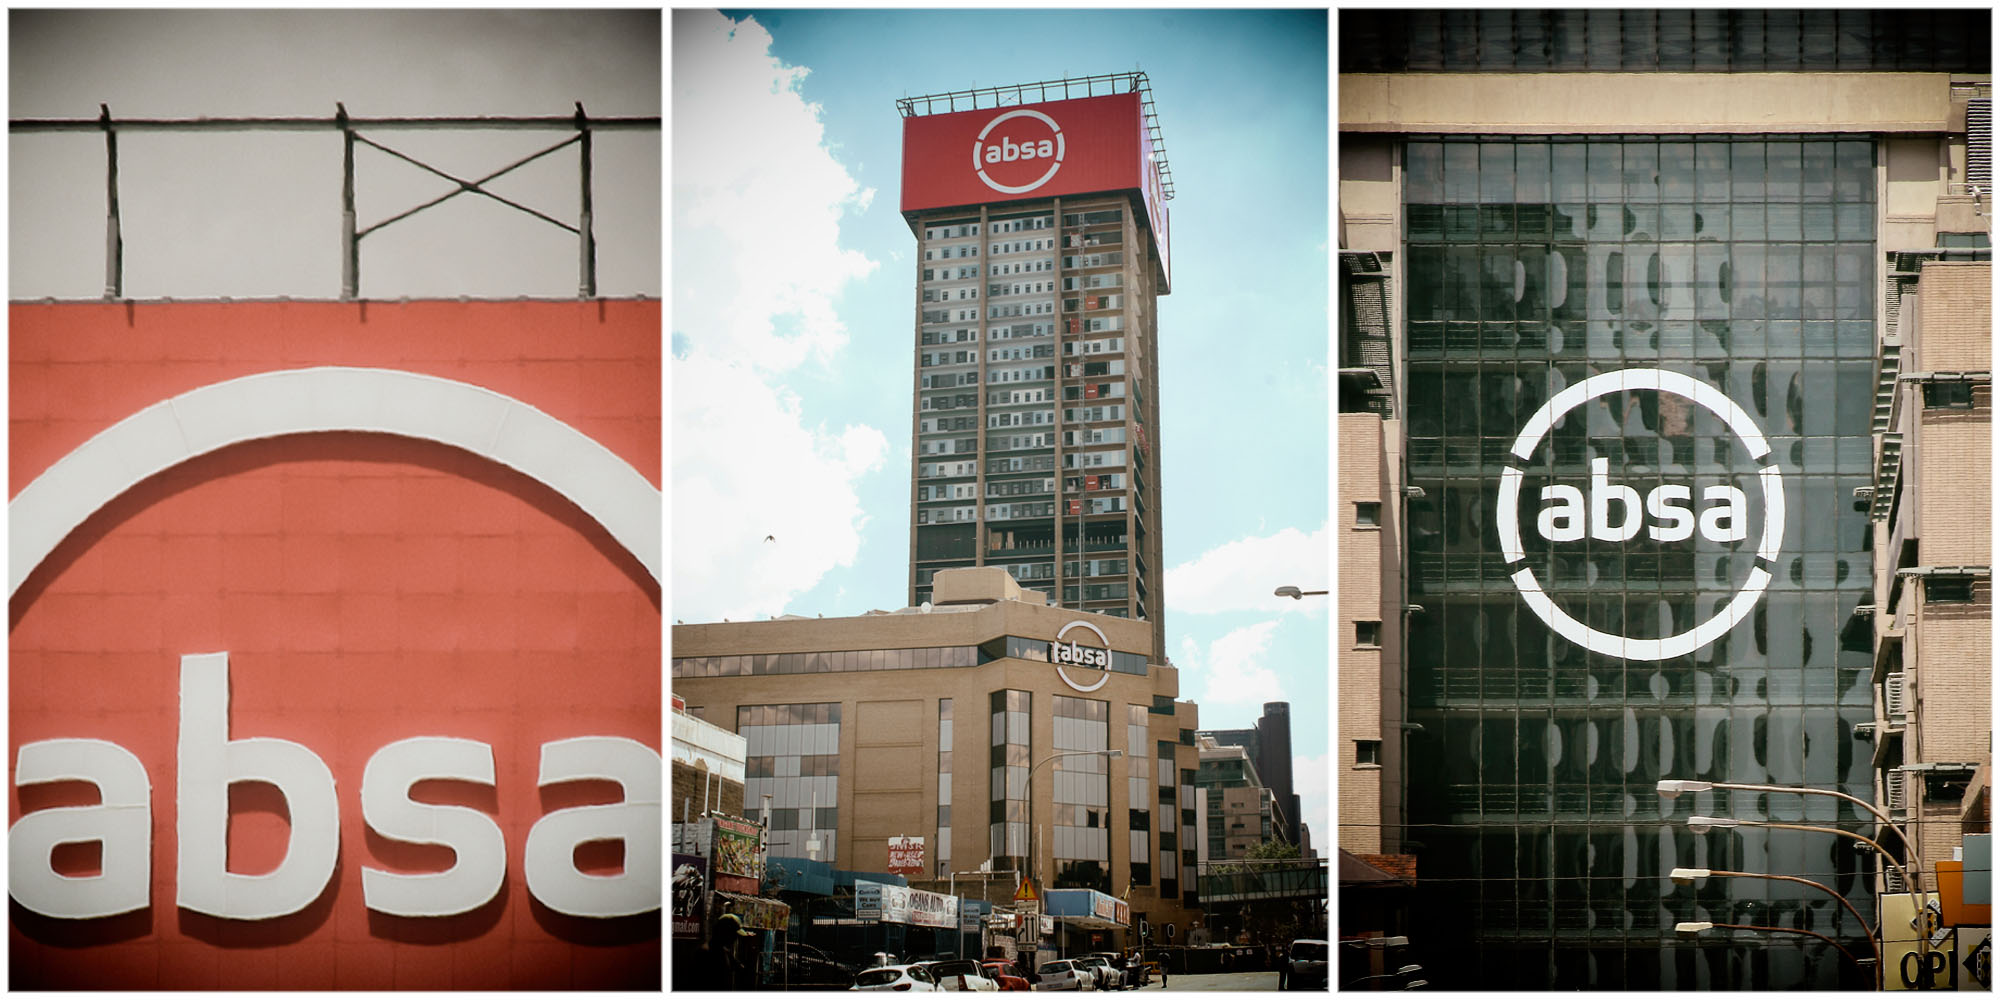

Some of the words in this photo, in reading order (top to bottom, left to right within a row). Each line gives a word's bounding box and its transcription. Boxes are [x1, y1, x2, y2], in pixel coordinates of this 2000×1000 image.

[985, 136, 1054, 164] absa
[1537, 457, 1747, 542] absa
[1060, 639, 1106, 666] absa
[8, 651, 662, 920] absa
